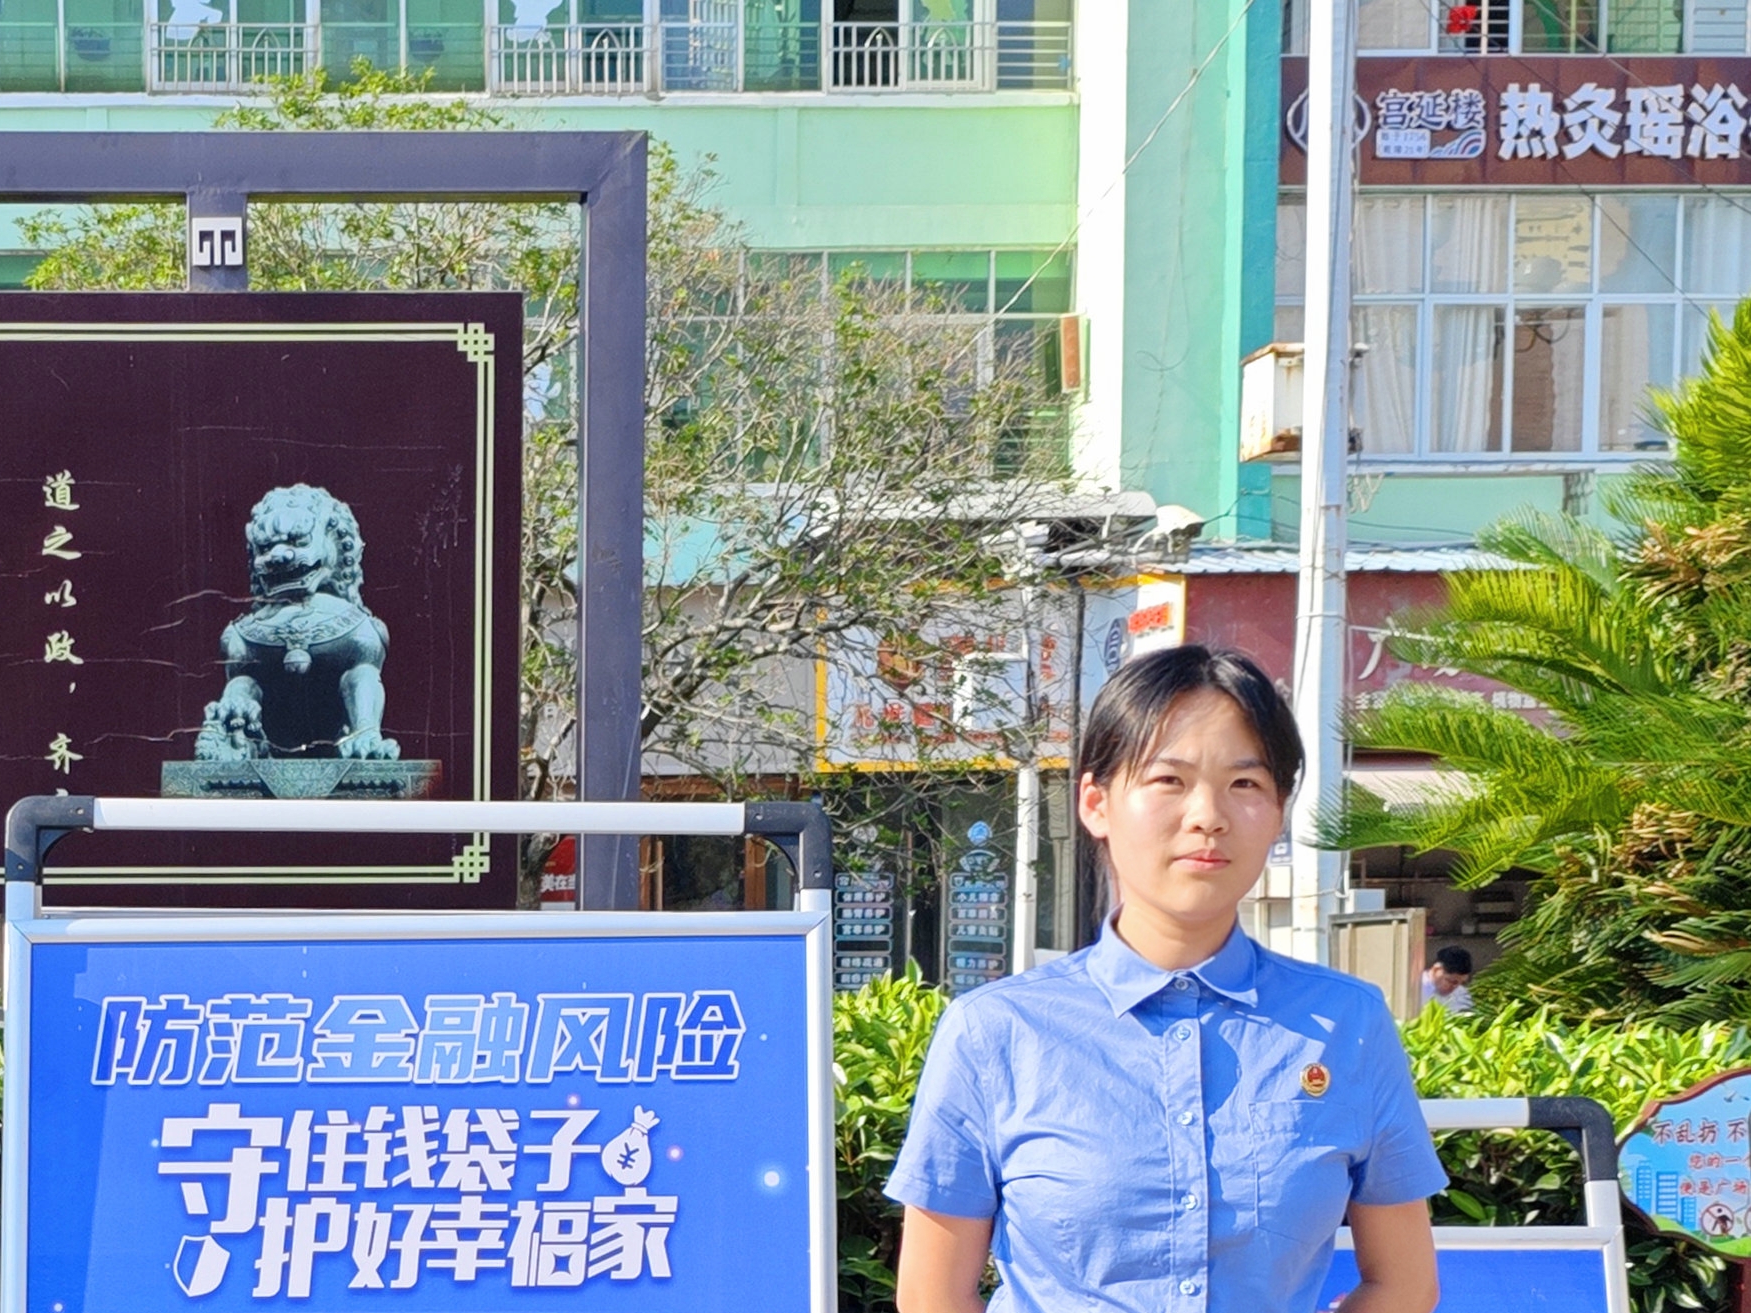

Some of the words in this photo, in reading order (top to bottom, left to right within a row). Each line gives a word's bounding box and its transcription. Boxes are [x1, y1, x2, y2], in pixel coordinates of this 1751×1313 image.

[1498, 82, 1748, 162] 热灸瑶浴
[42, 469, 84, 797] 道之以政，齐
[91, 990, 747, 1086] 防范金融风险
[158, 1103, 603, 1235] 守住钱袋子
[1652, 1117, 1718, 1147] 不乱扔
[253, 1188, 679, 1298] 护好幸福家
